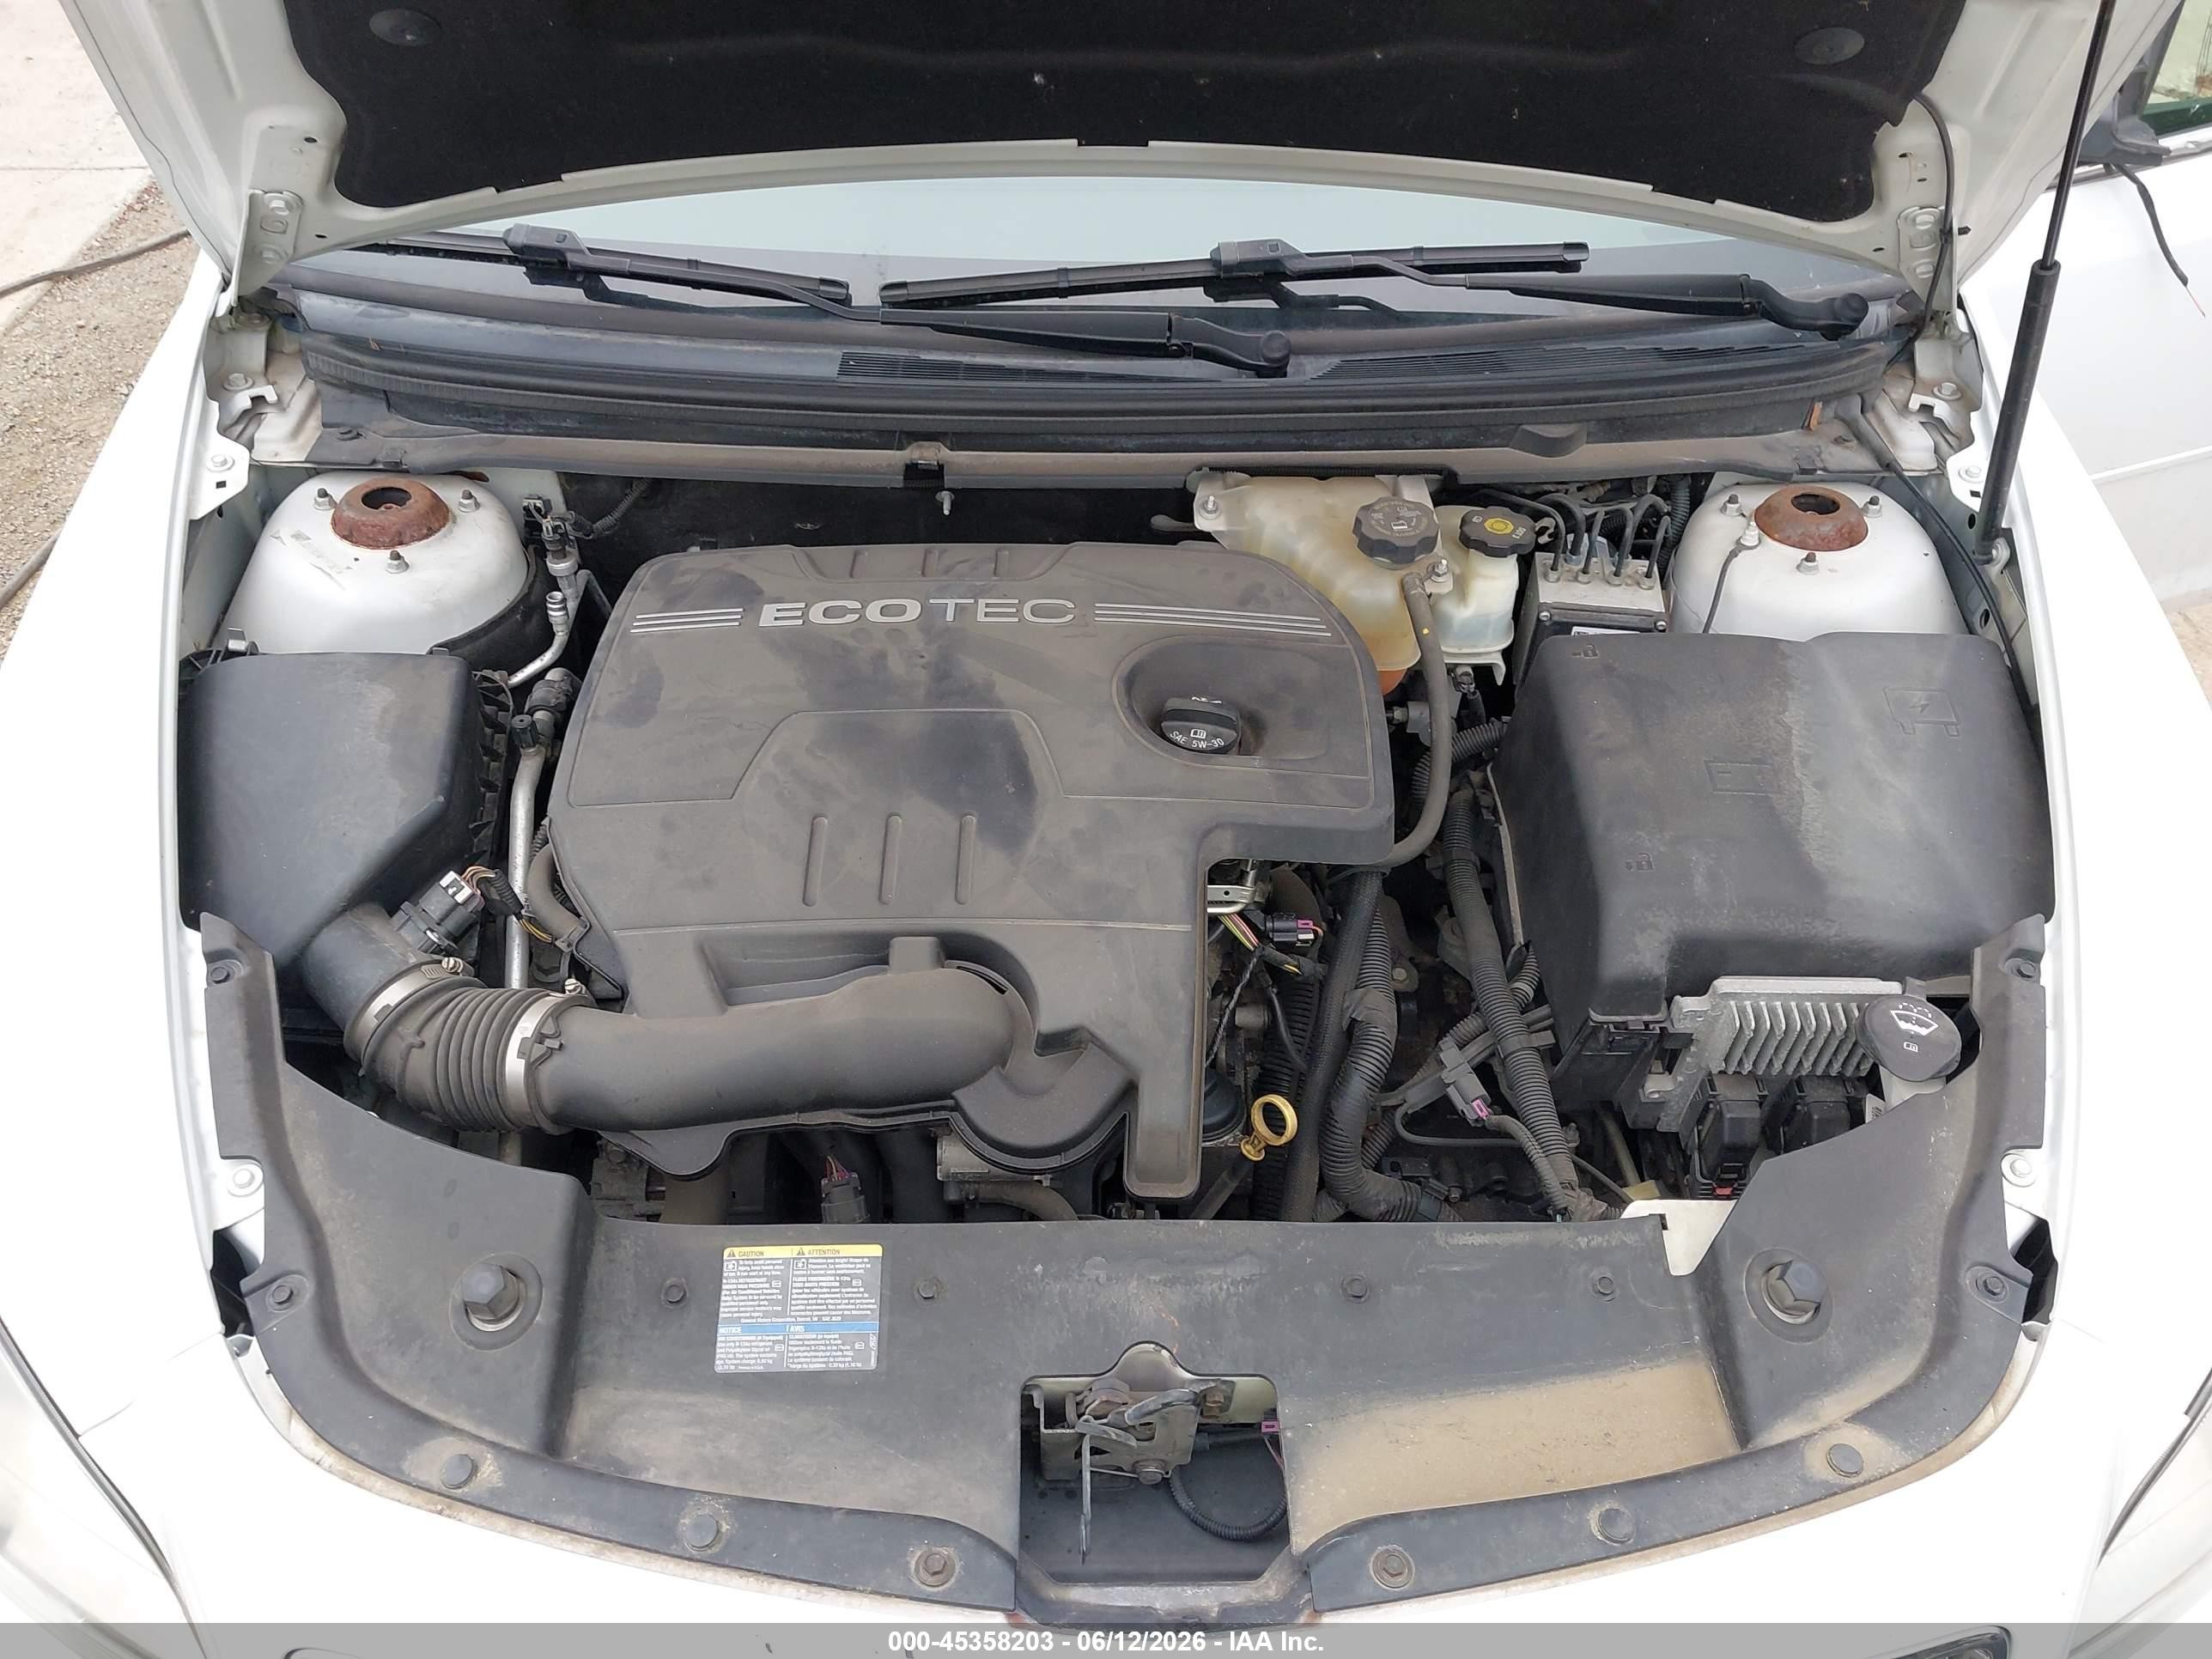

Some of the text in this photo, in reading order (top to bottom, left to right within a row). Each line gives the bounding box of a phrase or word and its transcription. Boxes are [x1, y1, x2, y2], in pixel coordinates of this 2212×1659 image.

[758, 598, 1076, 628] ECOTEC
[1170, 730, 1224, 750] SAE 5W-30
[719, 1326, 742, 1334] NOTICE
